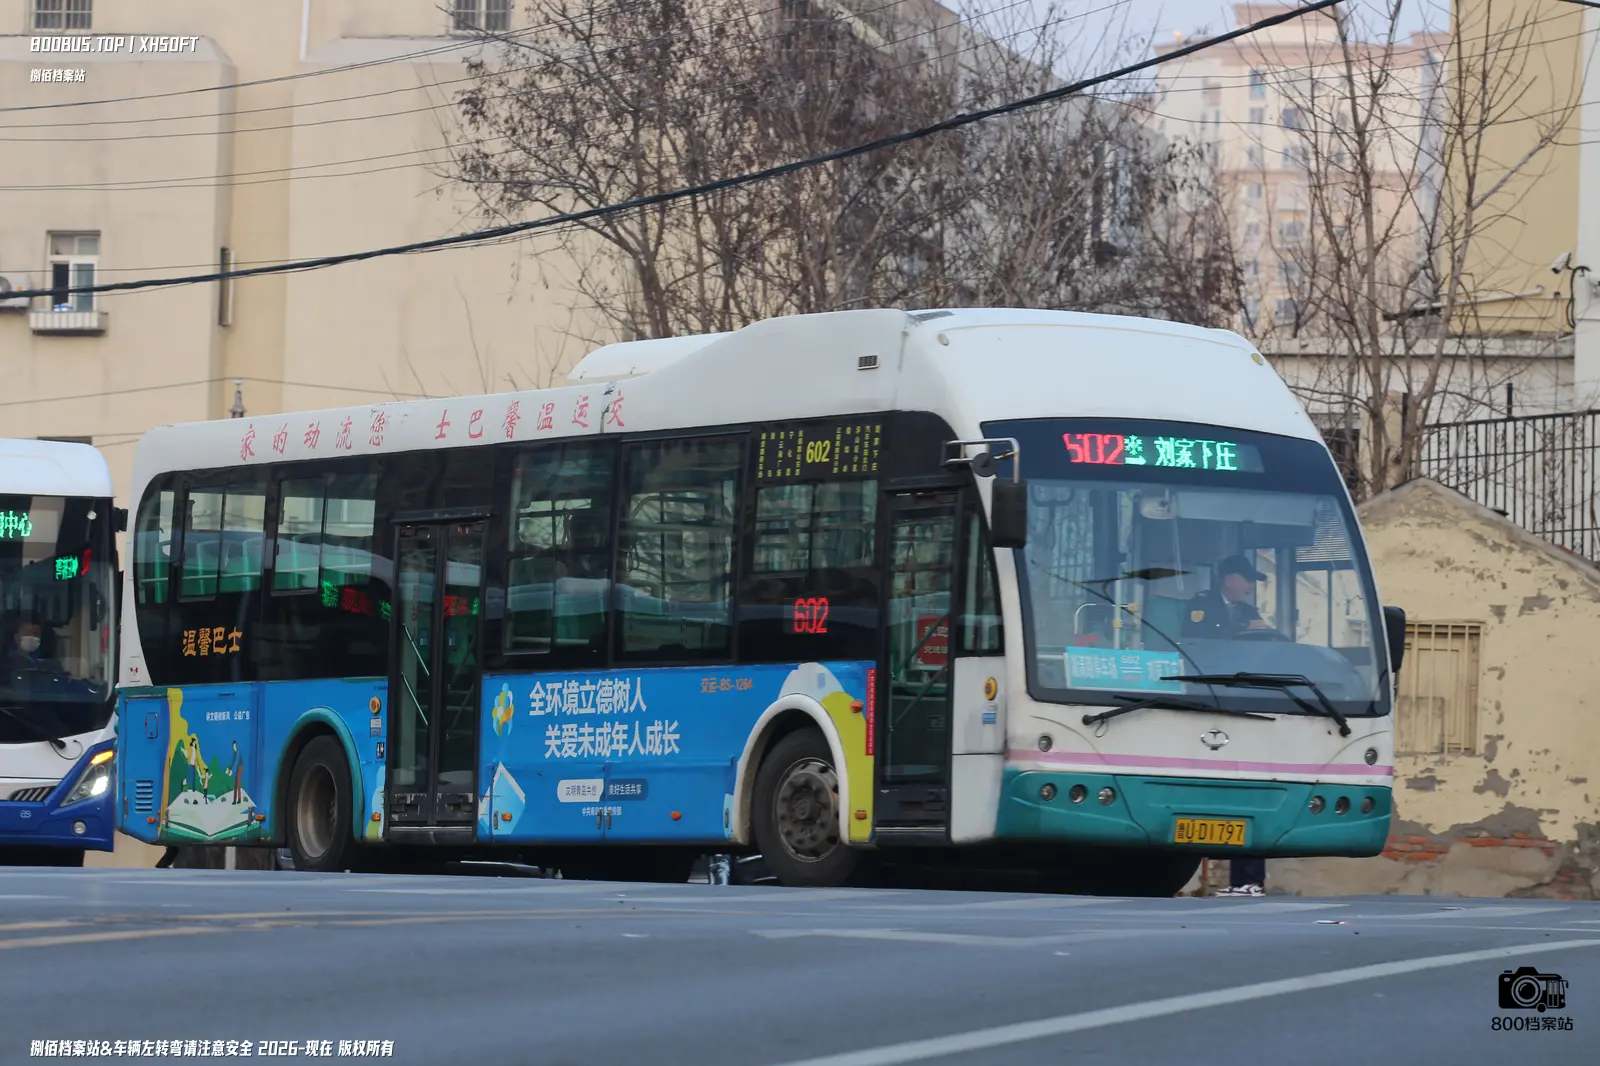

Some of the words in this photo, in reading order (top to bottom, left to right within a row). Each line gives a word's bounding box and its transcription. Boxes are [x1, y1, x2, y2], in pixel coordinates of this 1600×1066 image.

[806, 440, 831, 463] 602
[1154, 436, 1238, 471] 刘家下庄
[793, 597, 829, 633] 602
[182, 626, 243, 657] 温馨巴士
[529, 677, 647, 716] 全环境立德树人
[544, 720, 680, 759] 关爱未成年人成长
